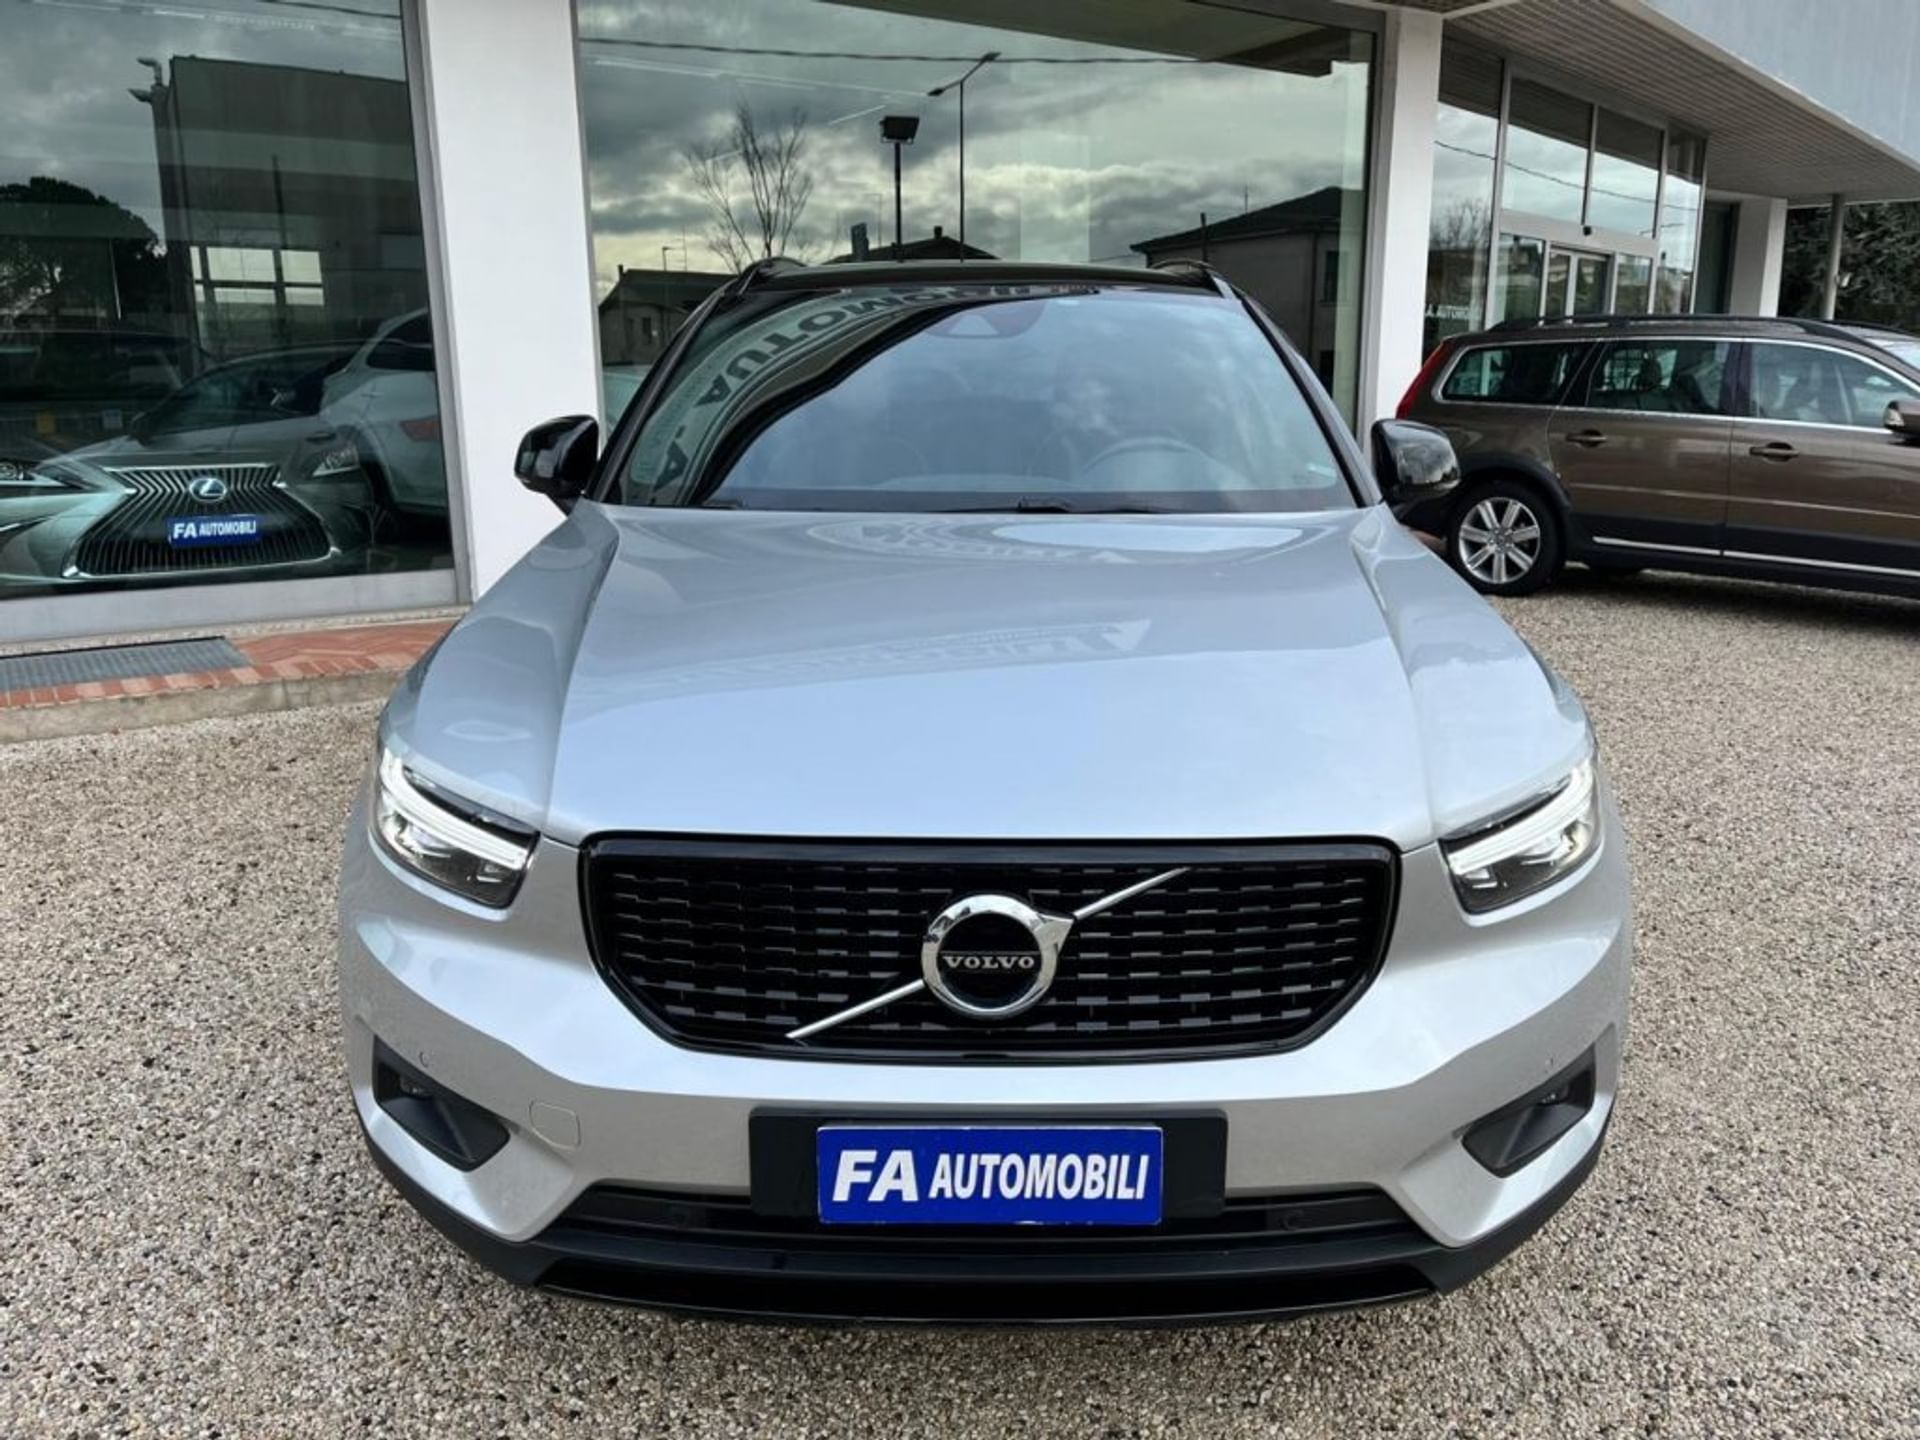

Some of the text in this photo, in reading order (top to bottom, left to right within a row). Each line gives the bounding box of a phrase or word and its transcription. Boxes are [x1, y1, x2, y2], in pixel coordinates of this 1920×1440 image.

[173, 520, 257, 539] FA AUTOMOBILI
[942, 955, 1035, 969] VOLVO
[832, 1149, 1149, 1202] FA AUTOMOBILI
